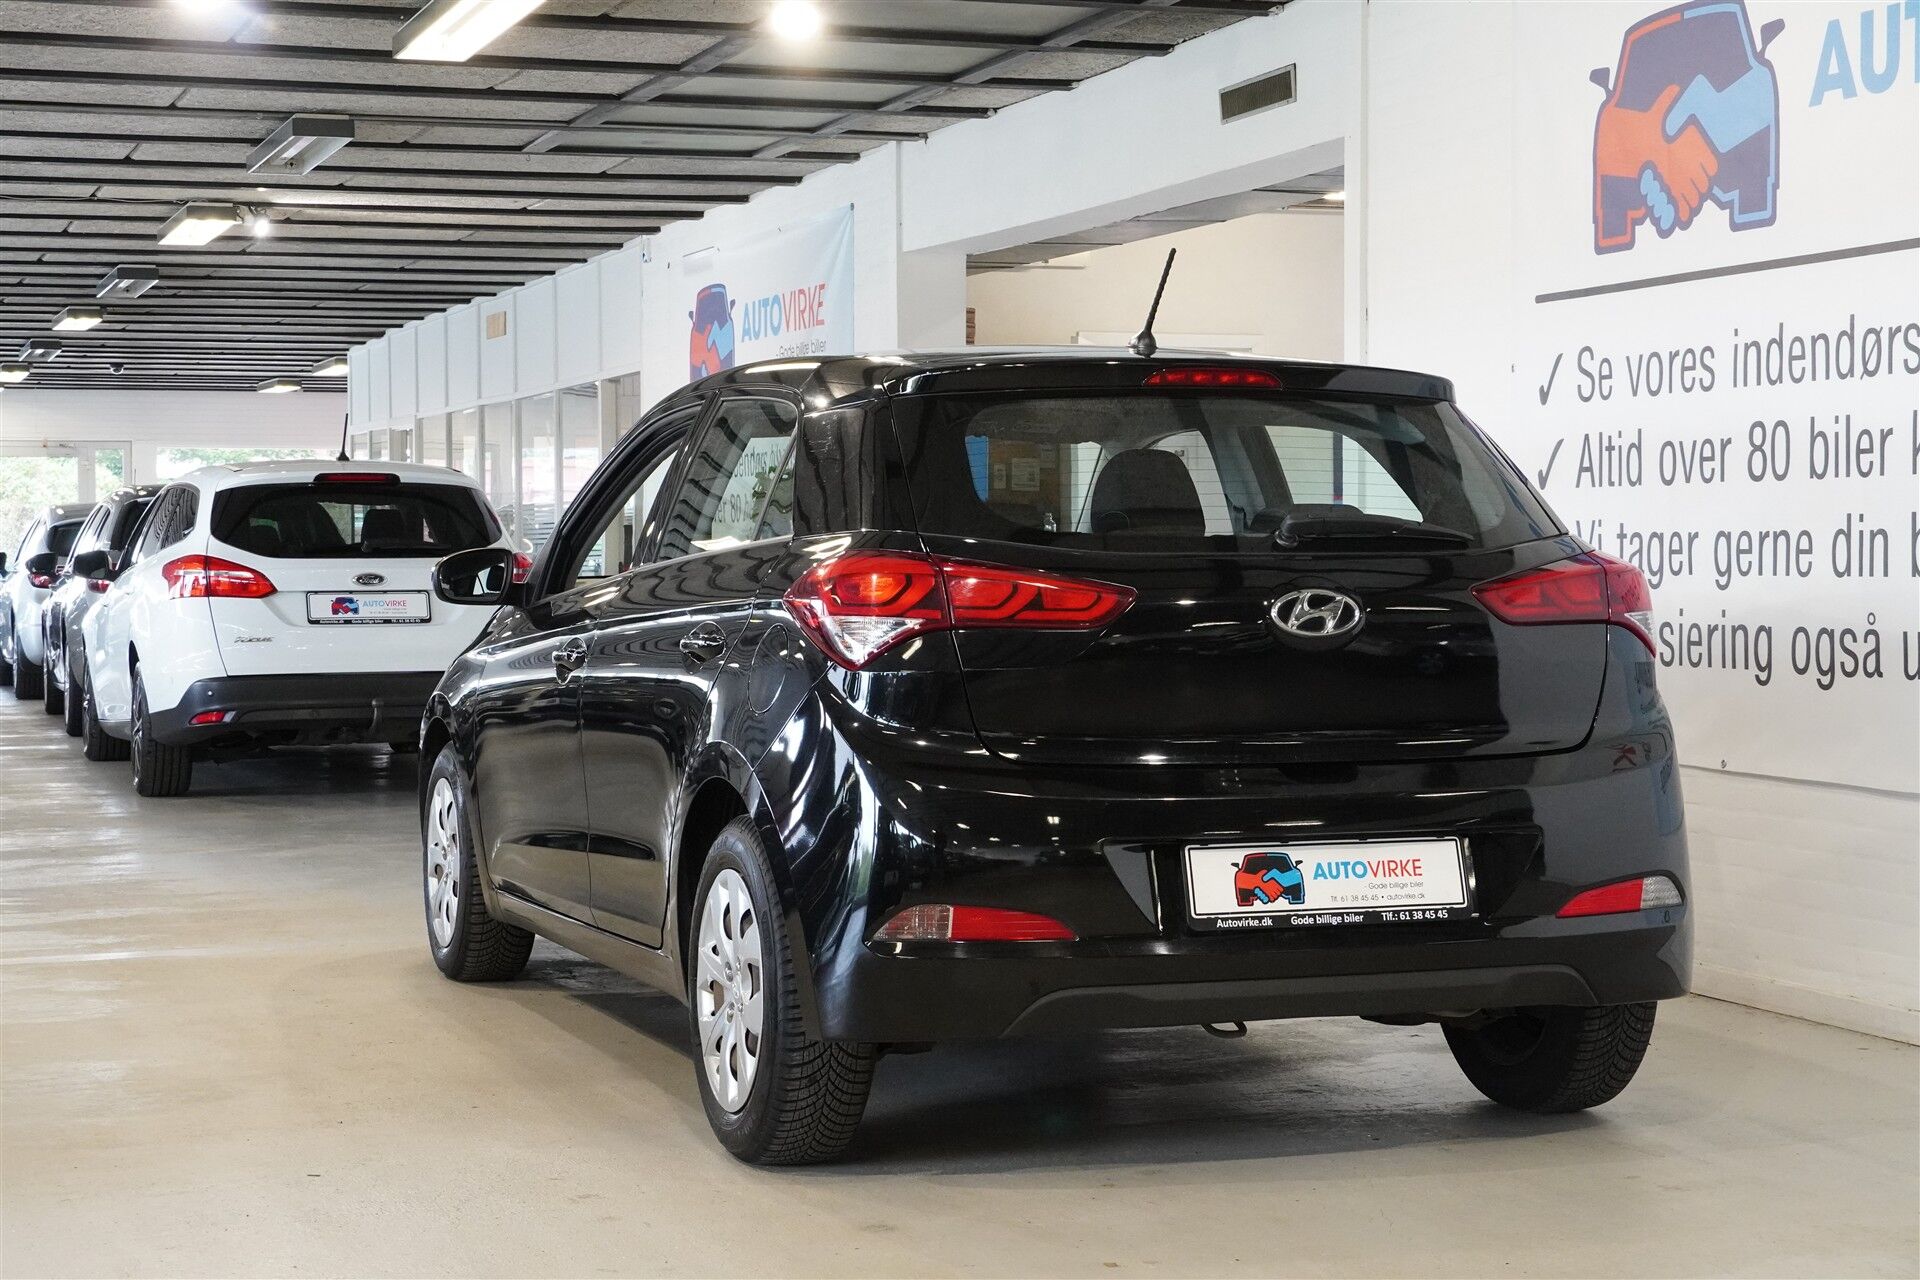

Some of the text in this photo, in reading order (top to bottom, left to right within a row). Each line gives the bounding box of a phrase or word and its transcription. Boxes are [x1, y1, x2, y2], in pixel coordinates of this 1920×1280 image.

[741, 283, 826, 343] AUTOVIRKE
[1576, 314, 1920, 403] Se vores indendørs
[1575, 428, 1643, 489] Altid
[1659, 436, 1732, 487] over
[1747, 419, 1791, 482] 80
[1809, 414, 1893, 480] biler
[1616, 522, 1699, 590] tager
[1713, 528, 1814, 591] gerne
[1831, 513, 1889, 578] din
[362, 599, 407, 607] AUTOVIRKE
[1791, 612, 1883, 691] også
[1313, 859, 1423, 881] AUTOVIRKE
[1368, 880, 1424, 891] Gode billige biler
[1360, 894, 1369, 902] 45
[1216, 917, 1273, 928] Autovirke.dk
[1291, 912, 1364, 927] Gode billige biler
[1381, 909, 1448, 921] Tlf.: 61 38 45 45
